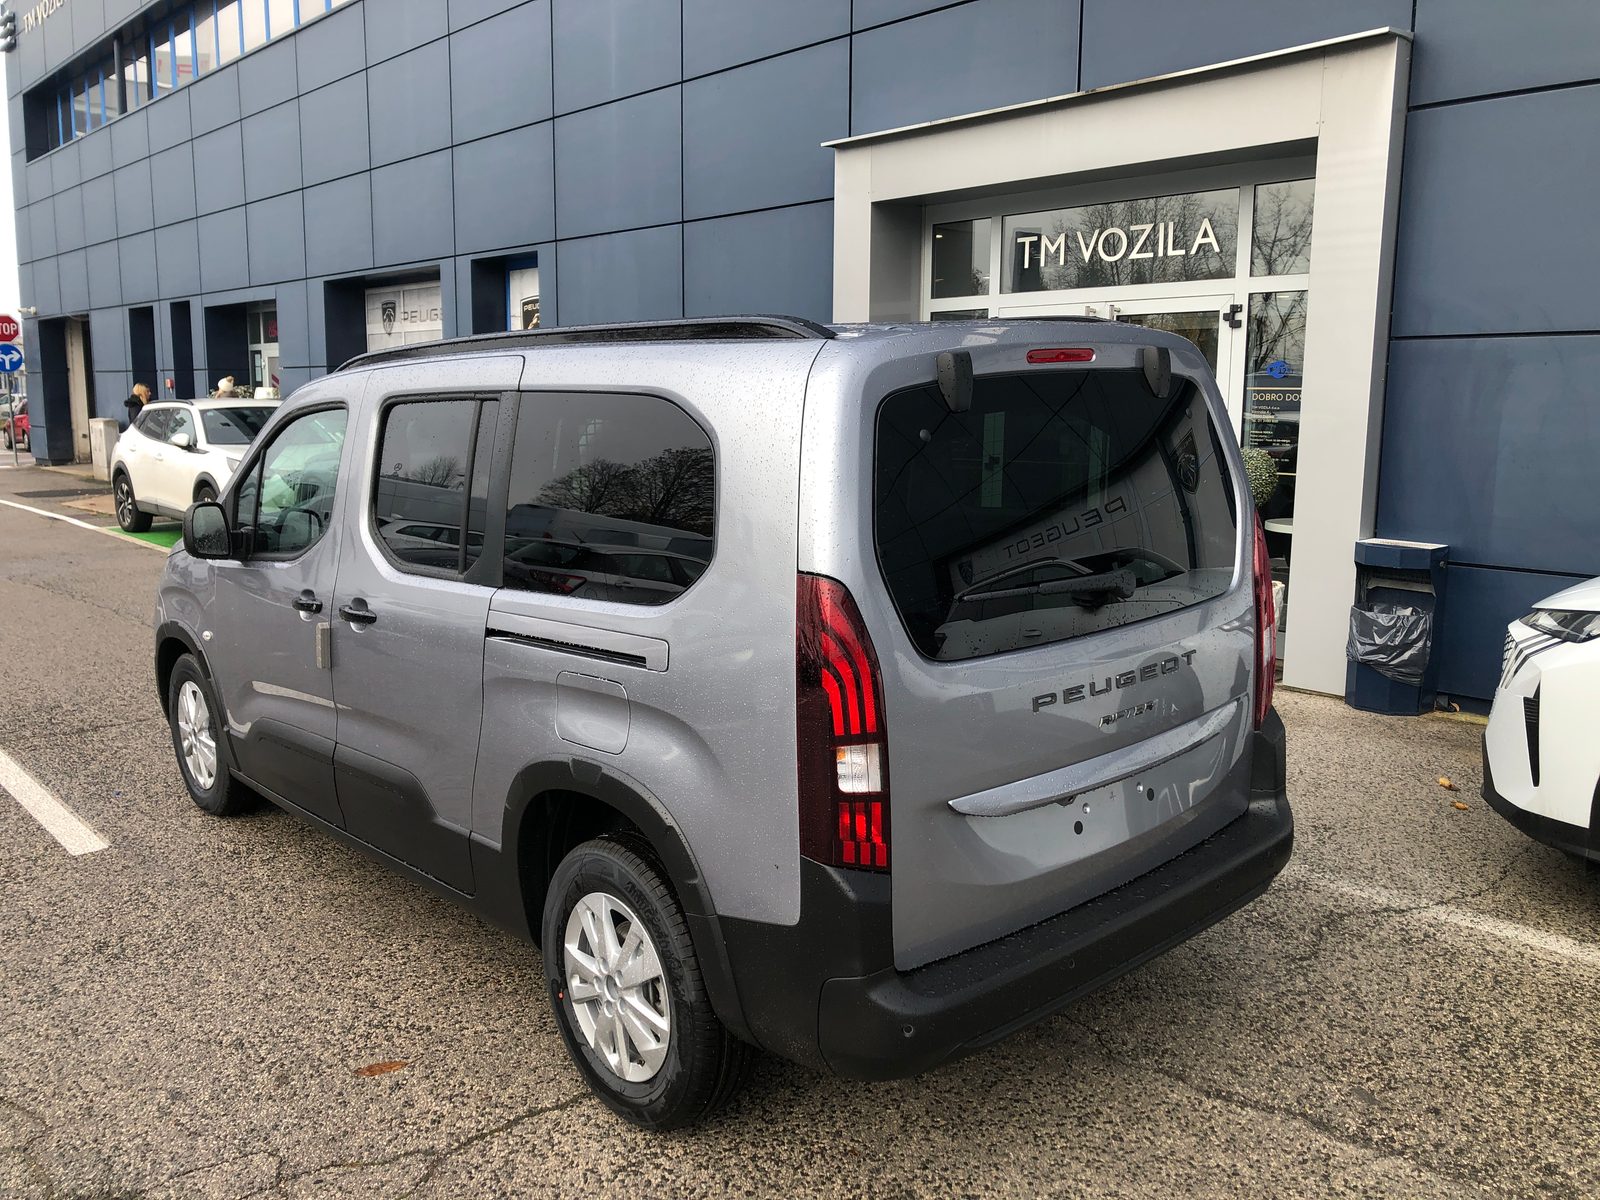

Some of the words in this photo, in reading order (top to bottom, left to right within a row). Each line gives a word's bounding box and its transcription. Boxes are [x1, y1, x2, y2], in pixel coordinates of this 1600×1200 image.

[1017, 232, 1066, 269] TM
[1077, 218, 1220, 263] VOZILA
[401, 308, 443, 324] PEUG
[1252, 393, 1284, 401] DOBRO
[1032, 649, 1197, 713] PEUGEOT
